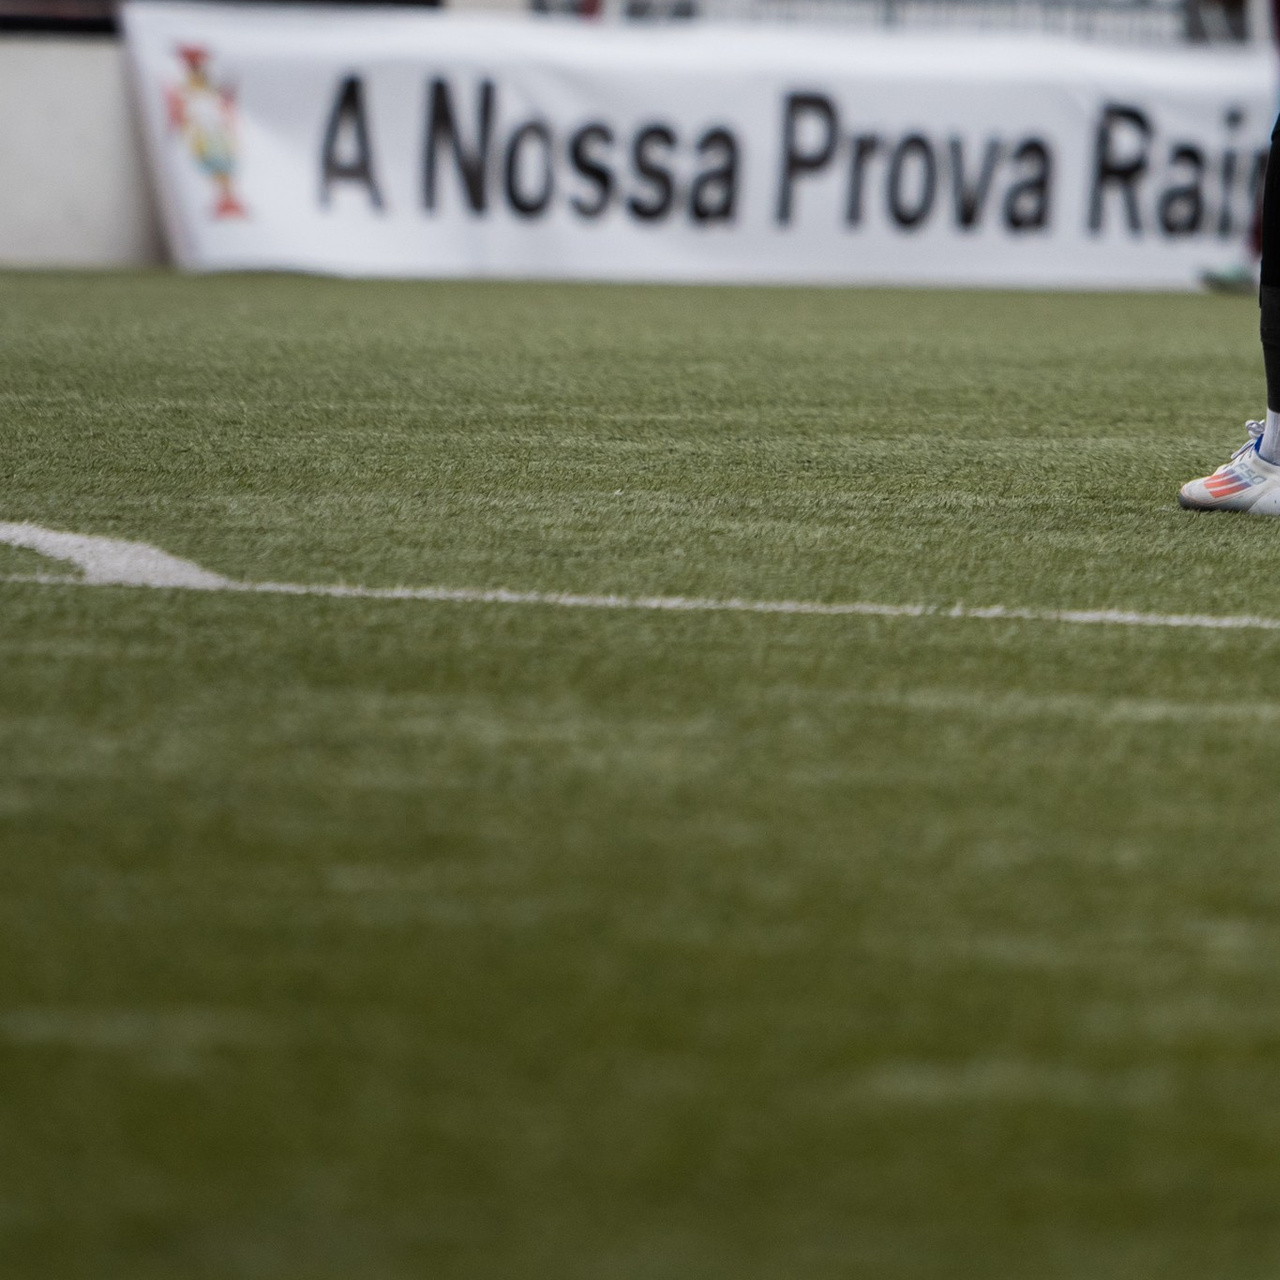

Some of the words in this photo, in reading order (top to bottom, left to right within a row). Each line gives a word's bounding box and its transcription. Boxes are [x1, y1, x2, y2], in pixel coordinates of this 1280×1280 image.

[318, 72, 384, 216] A
[422, 76, 742, 227] Nossa
[777, 92, 1052, 234] Prova
